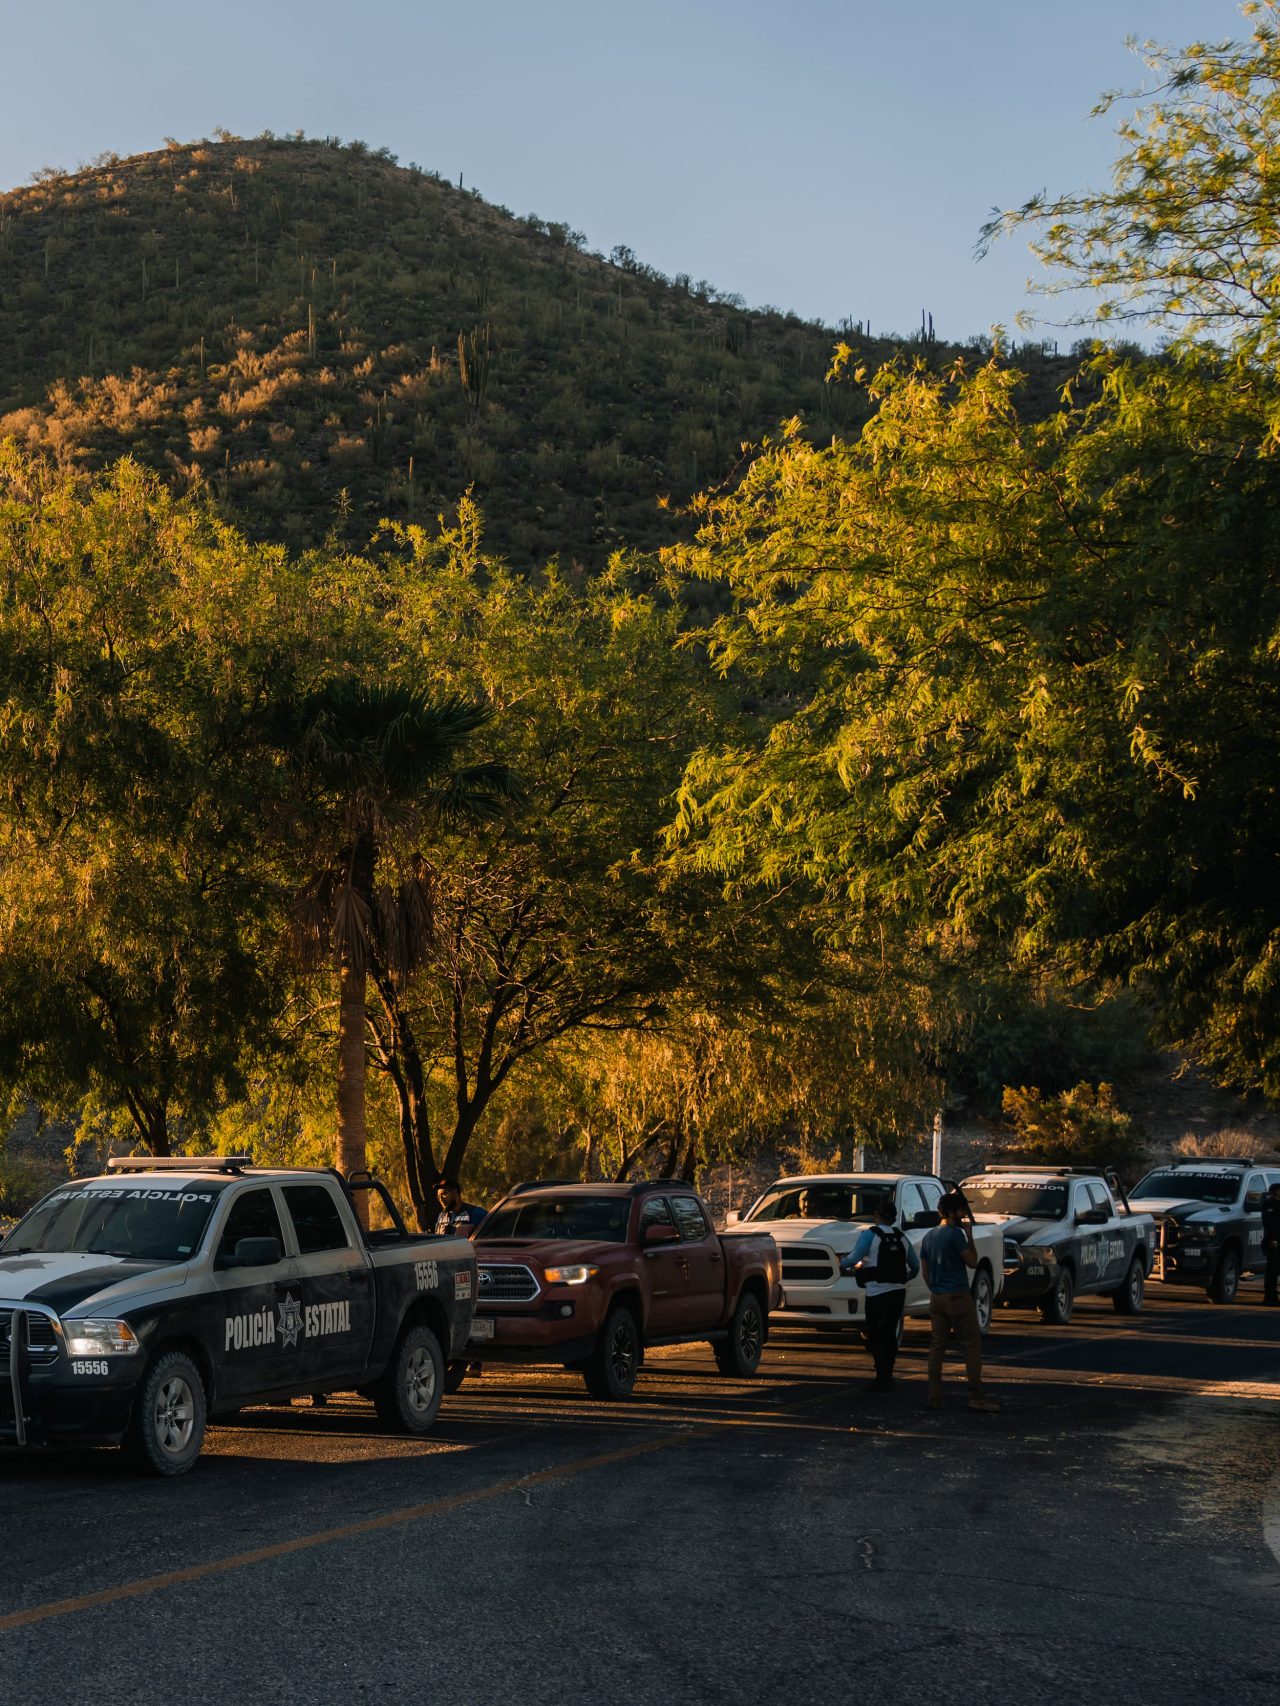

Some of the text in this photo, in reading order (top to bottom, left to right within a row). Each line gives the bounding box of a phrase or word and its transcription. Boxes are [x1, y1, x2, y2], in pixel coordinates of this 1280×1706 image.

[414, 1260, 439, 1291] 15556
[224, 1300, 351, 1351] POLICÍA ESTATAL
[71, 1361, 109, 1375] 15556
